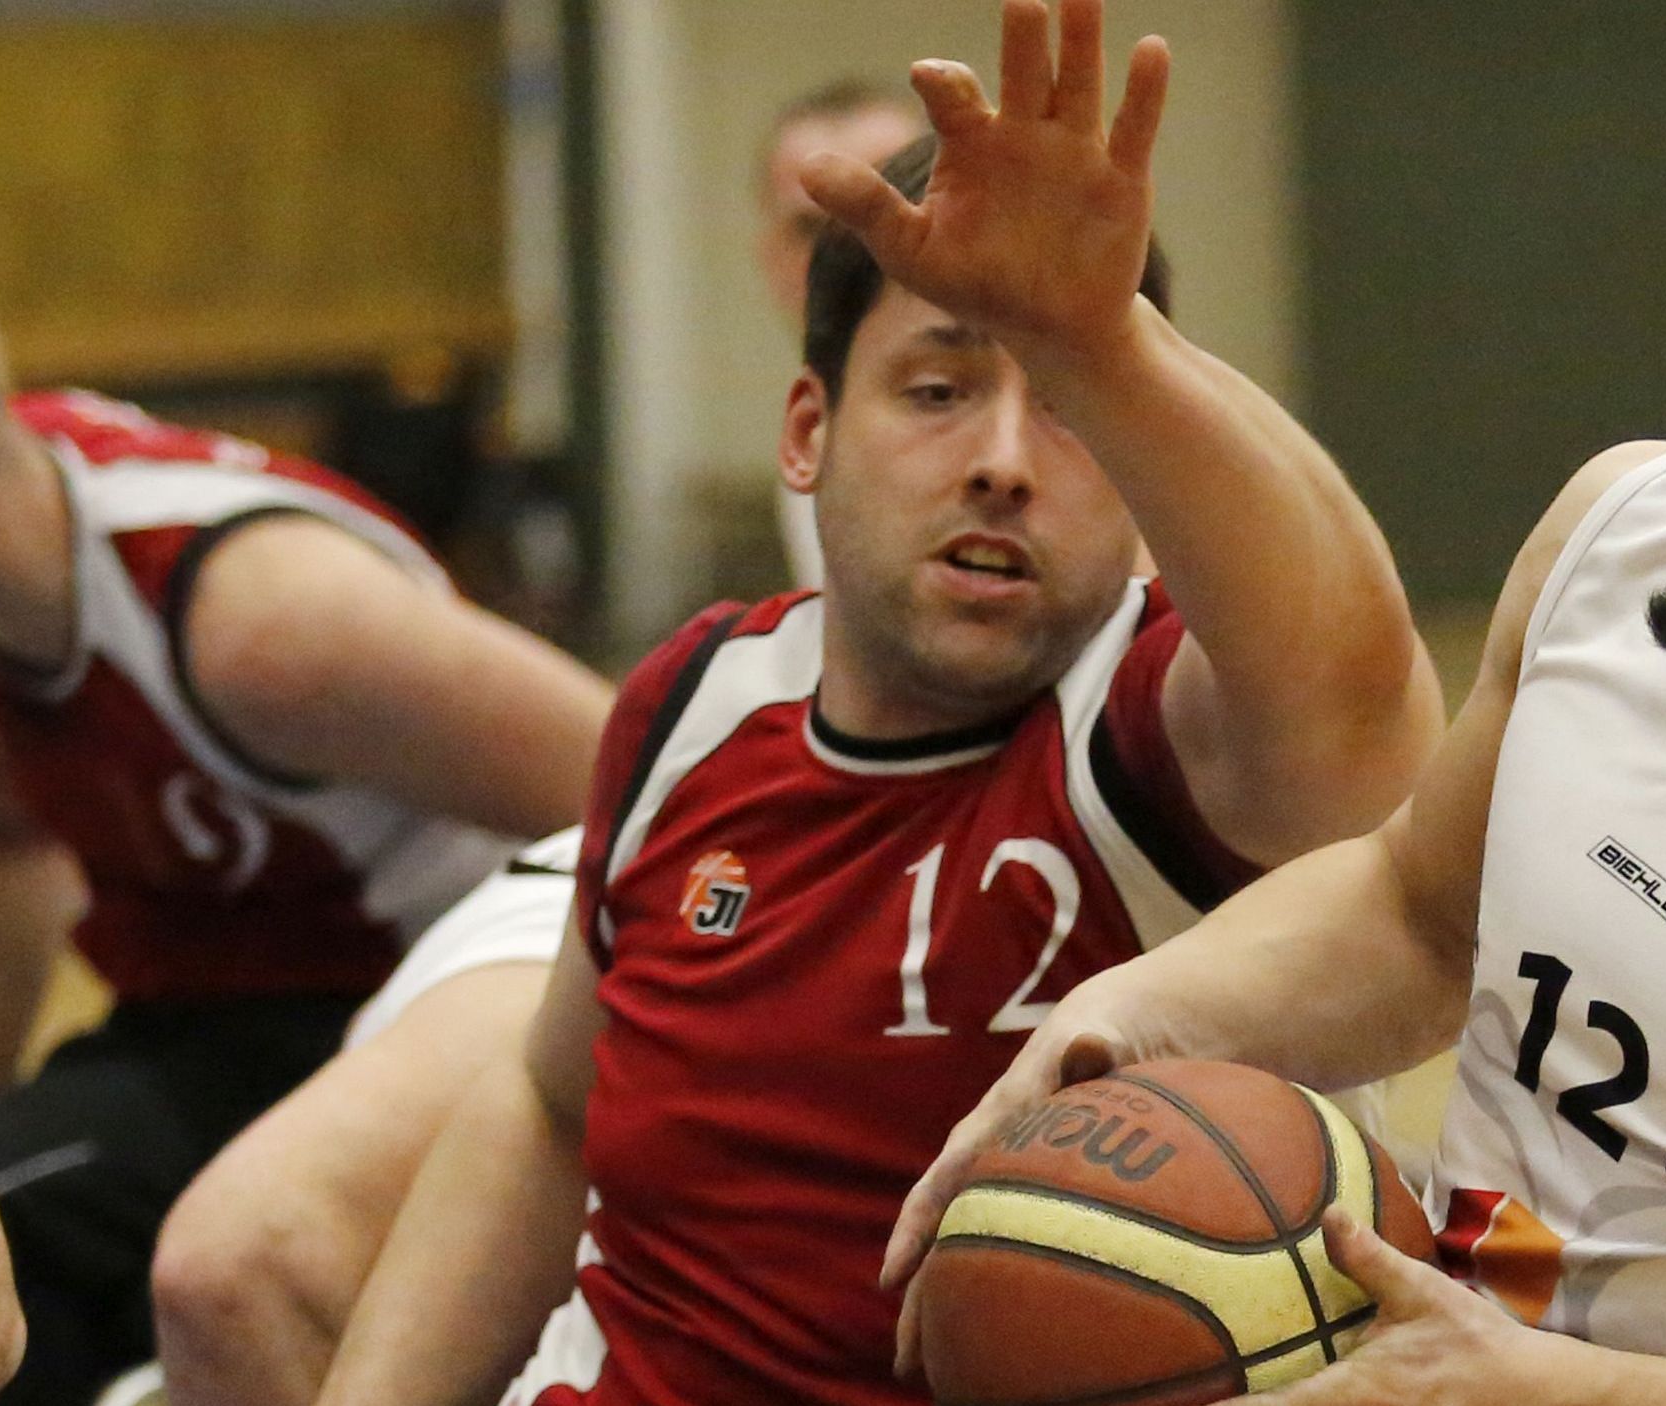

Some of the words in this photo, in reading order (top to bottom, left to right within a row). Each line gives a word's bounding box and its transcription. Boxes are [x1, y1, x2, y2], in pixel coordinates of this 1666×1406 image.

[694, 884, 746, 932] JI
[882, 836, 1081, 1037] 12
[1514, 950, 1650, 1163] 12
